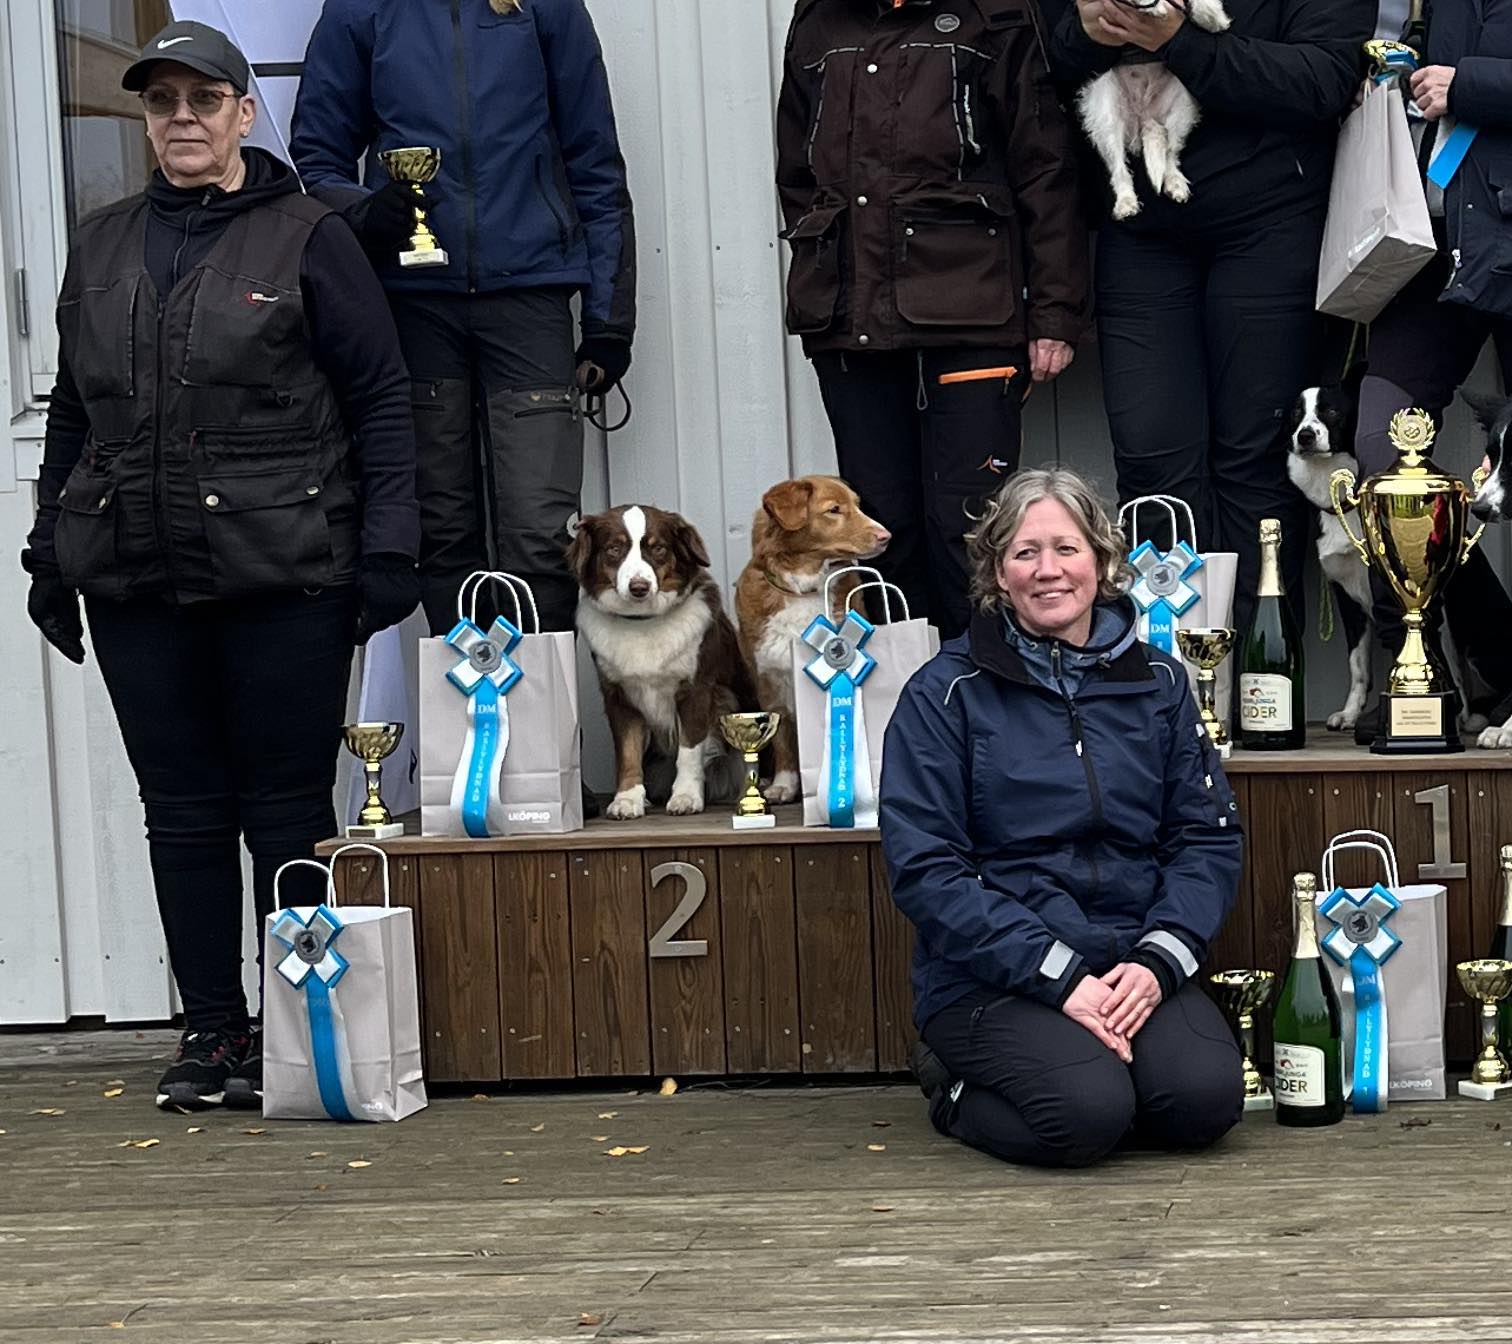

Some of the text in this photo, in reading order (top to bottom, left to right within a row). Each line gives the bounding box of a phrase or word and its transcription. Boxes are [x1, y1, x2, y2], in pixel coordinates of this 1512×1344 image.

[1151, 624, 1170, 633] DM
[832, 697, 852, 707] DM
[477, 704, 496, 713] DM
[1243, 706, 1277, 718] CIDER
[838, 714, 847, 791] RALLYLYDNAD
[838, 797, 846, 808] 2
[508, 810, 551, 822] LKÖPING
[1415, 784, 1466, 879] 1
[649, 862, 708, 957] 2
